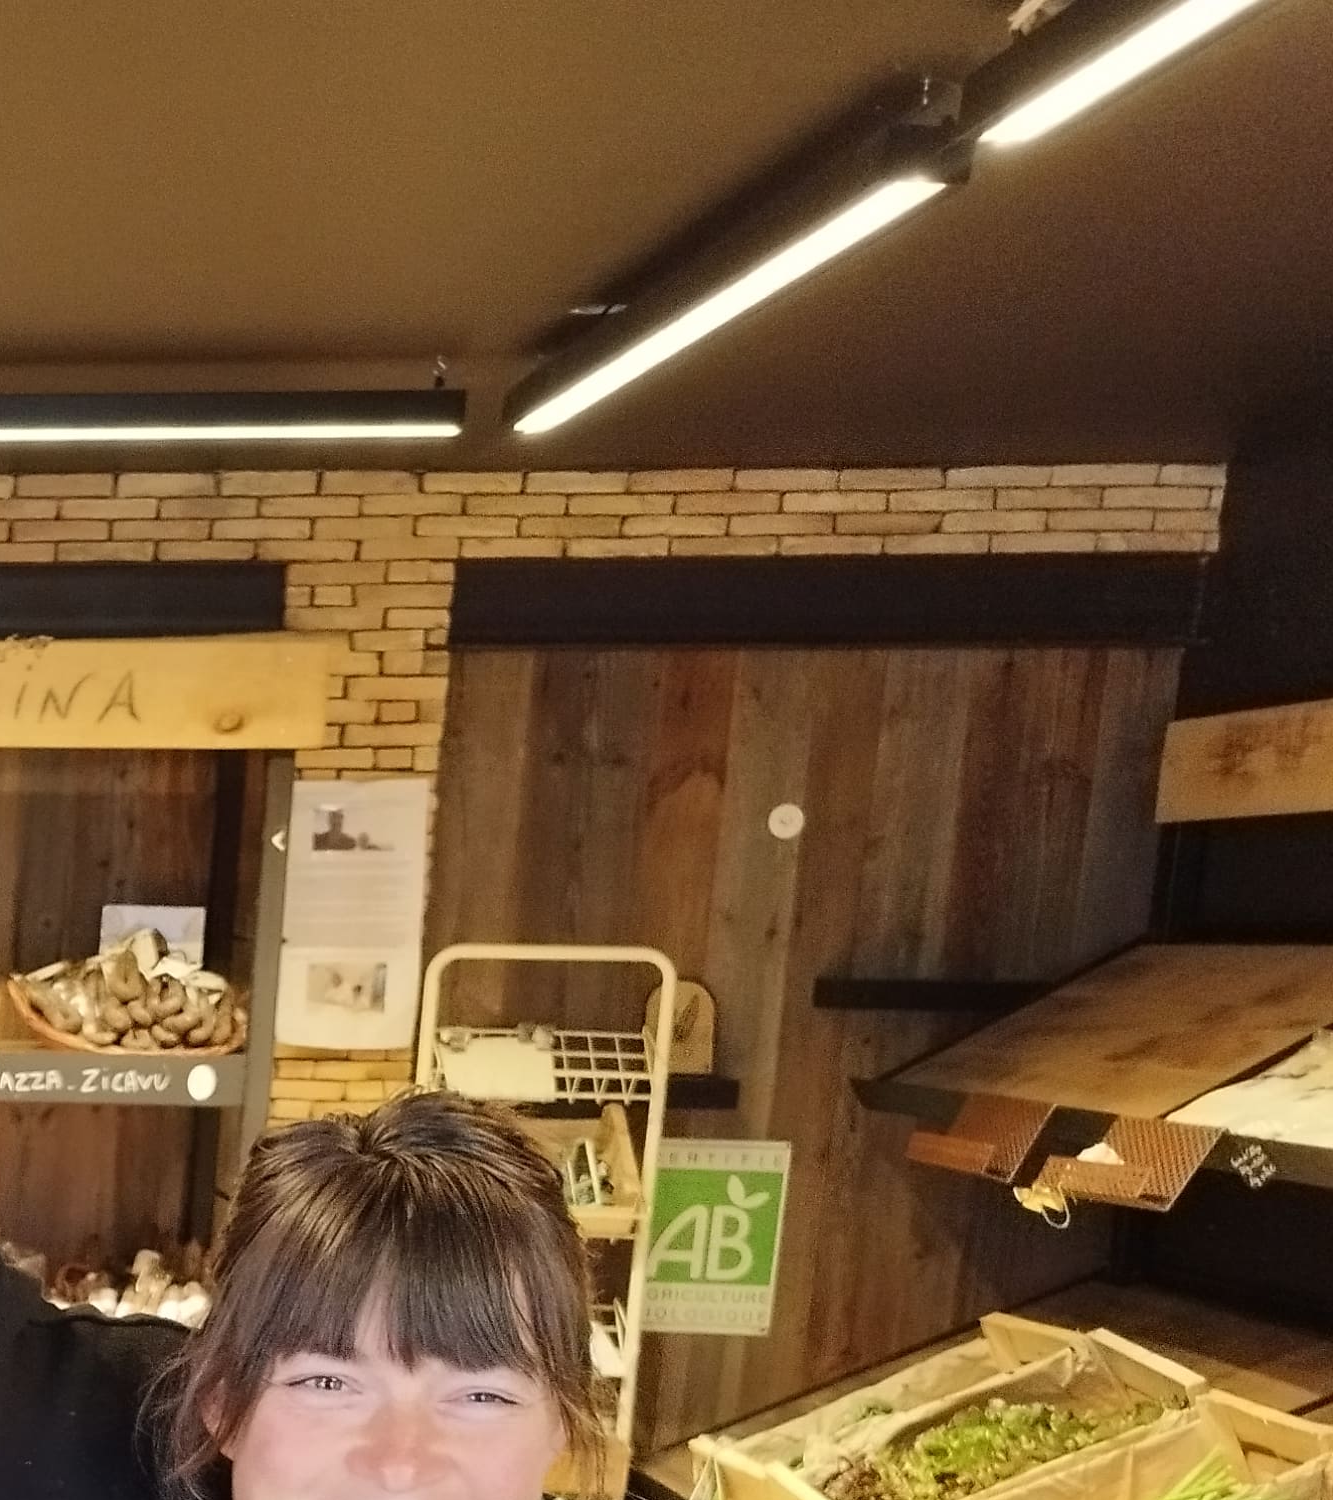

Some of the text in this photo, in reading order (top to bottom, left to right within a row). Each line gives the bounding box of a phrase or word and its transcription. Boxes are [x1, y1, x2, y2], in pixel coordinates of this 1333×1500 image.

[644, 1203, 754, 1282] AB
[645, 1287, 767, 1306] GRICULTURE
[645, 1306, 767, 1323] IOLOGIQUE
